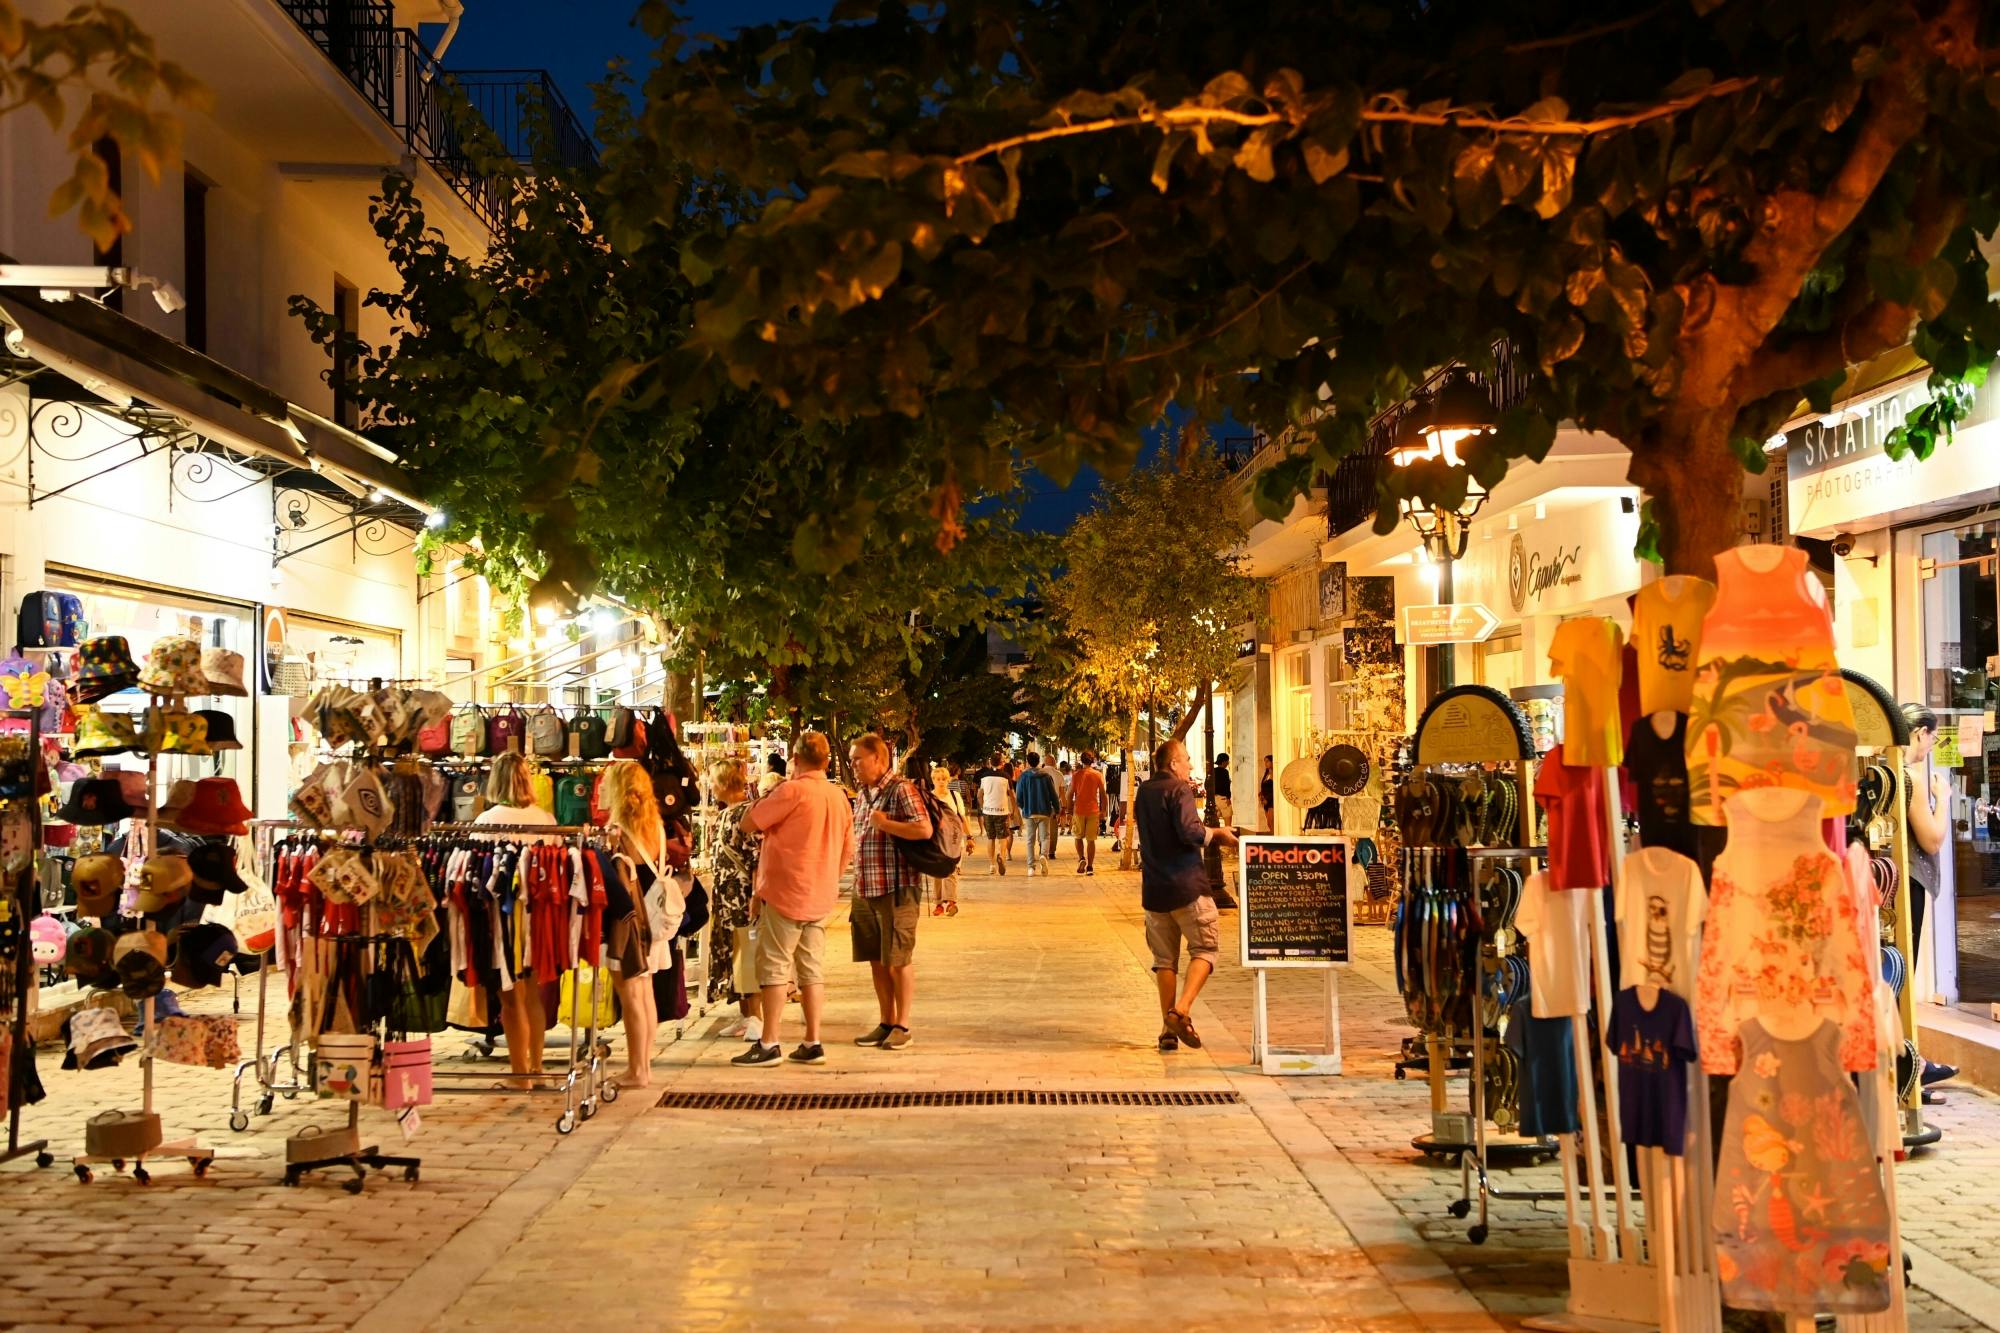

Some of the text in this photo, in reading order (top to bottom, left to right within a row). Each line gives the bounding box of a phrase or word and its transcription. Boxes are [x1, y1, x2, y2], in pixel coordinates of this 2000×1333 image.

[1807, 458, 1916, 502] PHOTOGRAPHY
[1246, 845, 1344, 864] Phedrock
[1261, 871, 1289, 880] OPEN
[1251, 919, 1290, 928] ENGLAND
[1251, 927, 1275, 935] SOUTH
